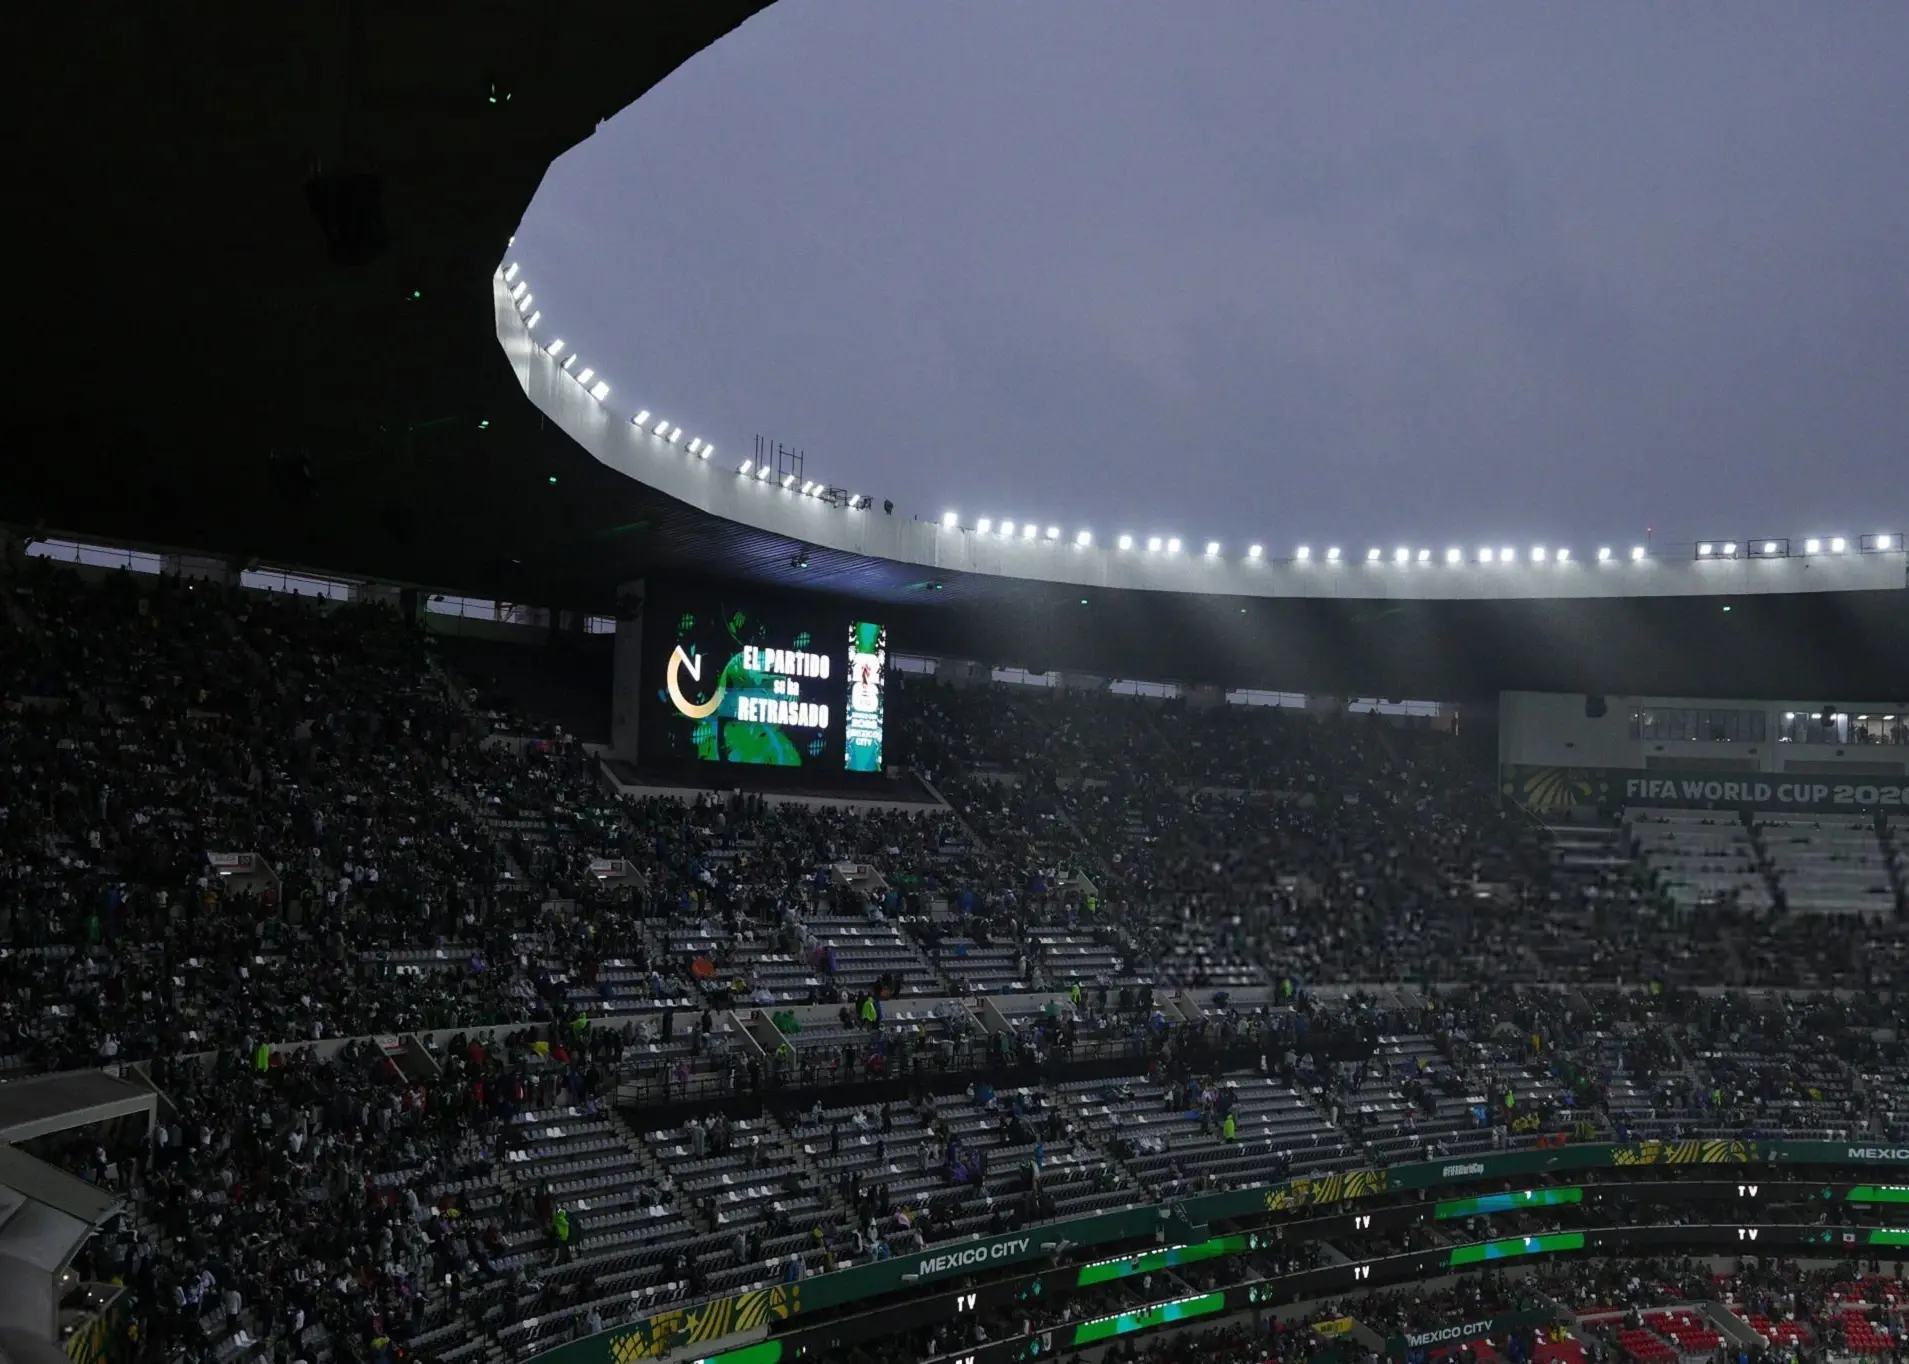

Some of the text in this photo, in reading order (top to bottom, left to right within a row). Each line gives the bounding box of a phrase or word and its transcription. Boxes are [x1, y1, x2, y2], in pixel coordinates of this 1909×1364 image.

[743, 645, 830, 679] EL PARTIDO
[738, 696, 829, 728] RETRASADO
[1626, 778, 1677, 799] FIFA
[1681, 780, 1771, 801] WORLD
[1777, 783, 1829, 803] CUP
[920, 1238, 1030, 1275] MEXICO CITY
[1410, 1319, 1493, 1347] MEXICO CITY
